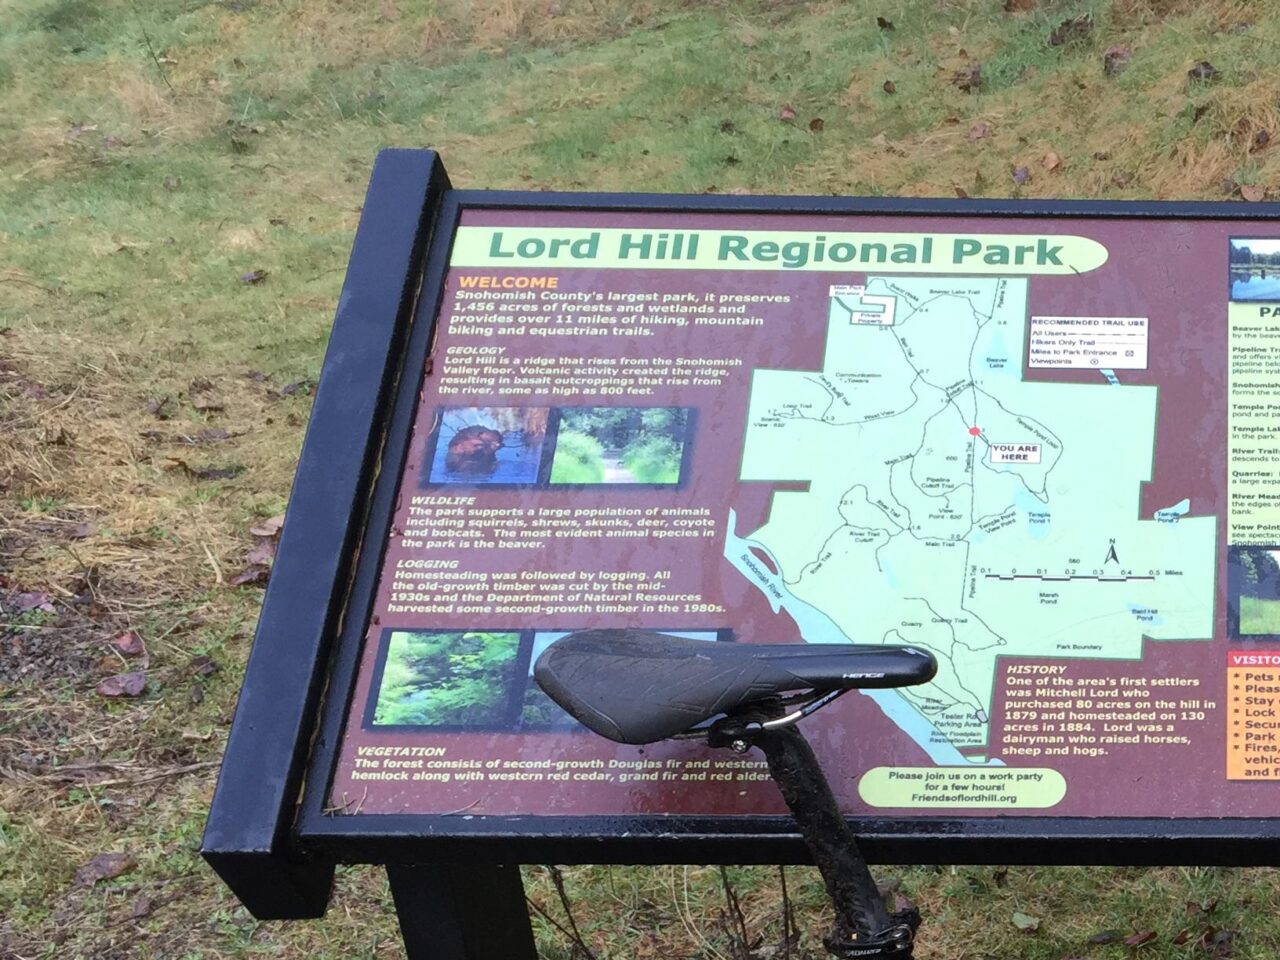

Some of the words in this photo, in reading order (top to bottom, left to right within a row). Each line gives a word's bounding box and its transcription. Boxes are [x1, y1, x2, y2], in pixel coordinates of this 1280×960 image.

[489, 232, 600, 259] Lord
[617, 233, 699, 260] Hill
[717, 234, 933, 268] Regional
[952, 239, 1065, 266] Park
[458, 276, 559, 288] WELCOME
[454, 289, 536, 300] Snohomish
[539, 290, 603, 302] County's
[607, 290, 659, 303] largest
[662, 291, 699, 303] park,
[704, 291, 715, 301] it
[718, 294, 790, 303] preserves
[453, 301, 495, 313] 1,456
[542, 301, 558, 312] of
[561, 301, 612, 312] forests
[616, 302, 644, 312] and
[647, 302, 714, 312] wetlands
[718, 302, 746, 312] and
[449, 313, 513, 325] provides
[517, 315, 551, 323] over
[555, 313, 572, 323] 11
[577, 313, 617, 323] miles
[620, 313, 637, 324] of
[640, 313, 689, 326] hiking,
[694, 314, 763, 324] mountain
[447, 324, 494, 337] biking
[497, 324, 525, 335] and
[528, 324, 608, 337] equestrian
[612, 325, 654, 335] trails.
[1058, 338, 1076, 346] Only
[446, 346, 506, 354] GEOLOGY
[1030, 357, 1072, 365] Viewpoints
[1231, 425, 1265, 433] Temple
[992, 444, 1014, 452] YOU
[411, 496, 476, 505] WILDLIFE
[396, 559, 459, 568] LOGGING
[1071, 643, 1102, 651] Boundary
[1006, 665, 1067, 674] HISTORY
[1006, 675, 1032, 685] One
[1035, 675, 1049, 685] of
[1052, 675, 1074, 685] the
[1076, 676, 1116, 685] area's
[1119, 676, 1147, 685] first
[1150, 676, 1199, 685] settlers
[1244, 672, 1274, 681] Pets
[1035, 687, 1086, 696] Mitchell
[1089, 687, 1118, 696] Lord
[1122, 687, 1150, 696] who
[1244, 695, 1274, 707] Stay
[1245, 707, 1275, 717] Lock
[1244, 731, 1275, 741] Park
[357, 746, 446, 756] VEGETATION
[1244, 742, 1280, 753] Fires,
[1244, 766, 1269, 776] and
[888, 771, 923, 779] Please
[924, 771, 945, 781] join
[987, 771, 1014, 780] work
[1015, 771, 1043, 782] party
[924, 782, 940, 790] for
[950, 782, 969, 790] few
[971, 782, 1005, 790] hours!
[911, 793, 1017, 803] Friendsoflordhill.org
